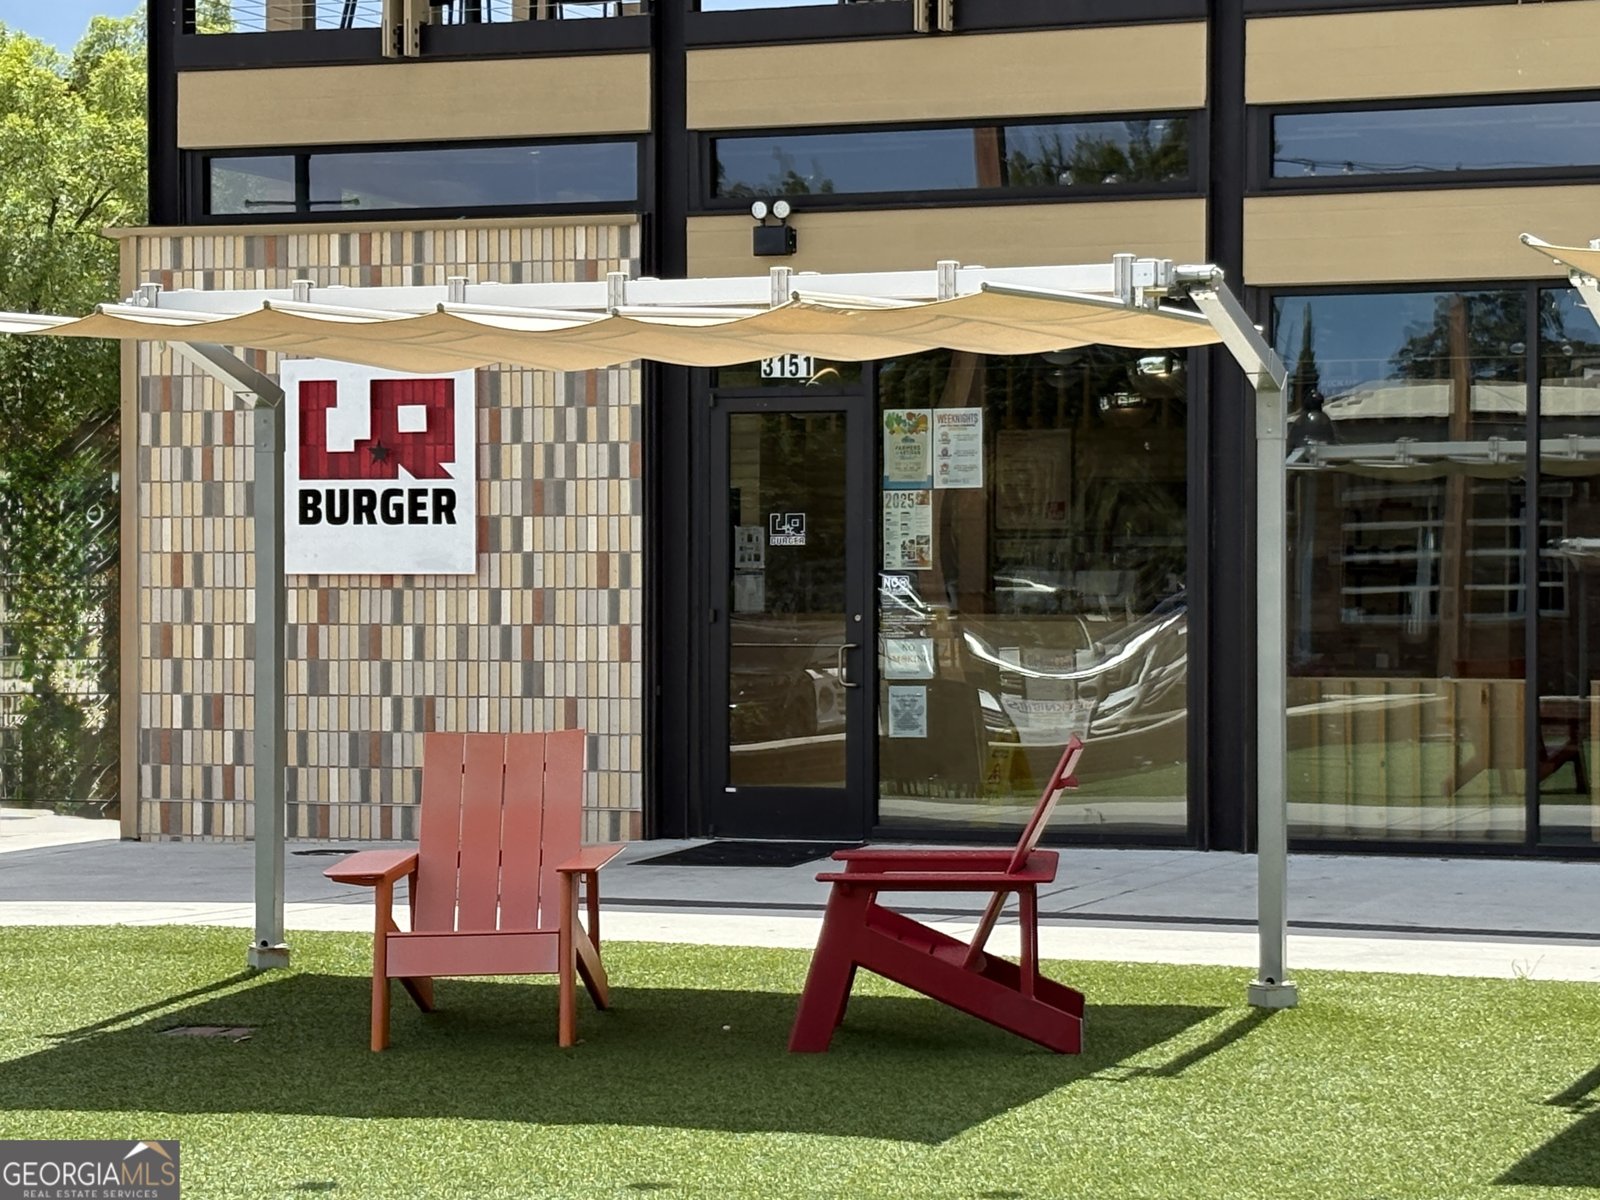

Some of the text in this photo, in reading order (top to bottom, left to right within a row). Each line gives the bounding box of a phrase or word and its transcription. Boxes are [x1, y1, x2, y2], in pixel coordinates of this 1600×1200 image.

[763, 354, 811, 377] 3151
[937, 413, 979, 424] WEEKNIGHTS
[299, 488, 457, 525] BURGER
[885, 493, 914, 509] 2025
[770, 537, 806, 545] BURGER
[902, 642, 915, 651] NO
